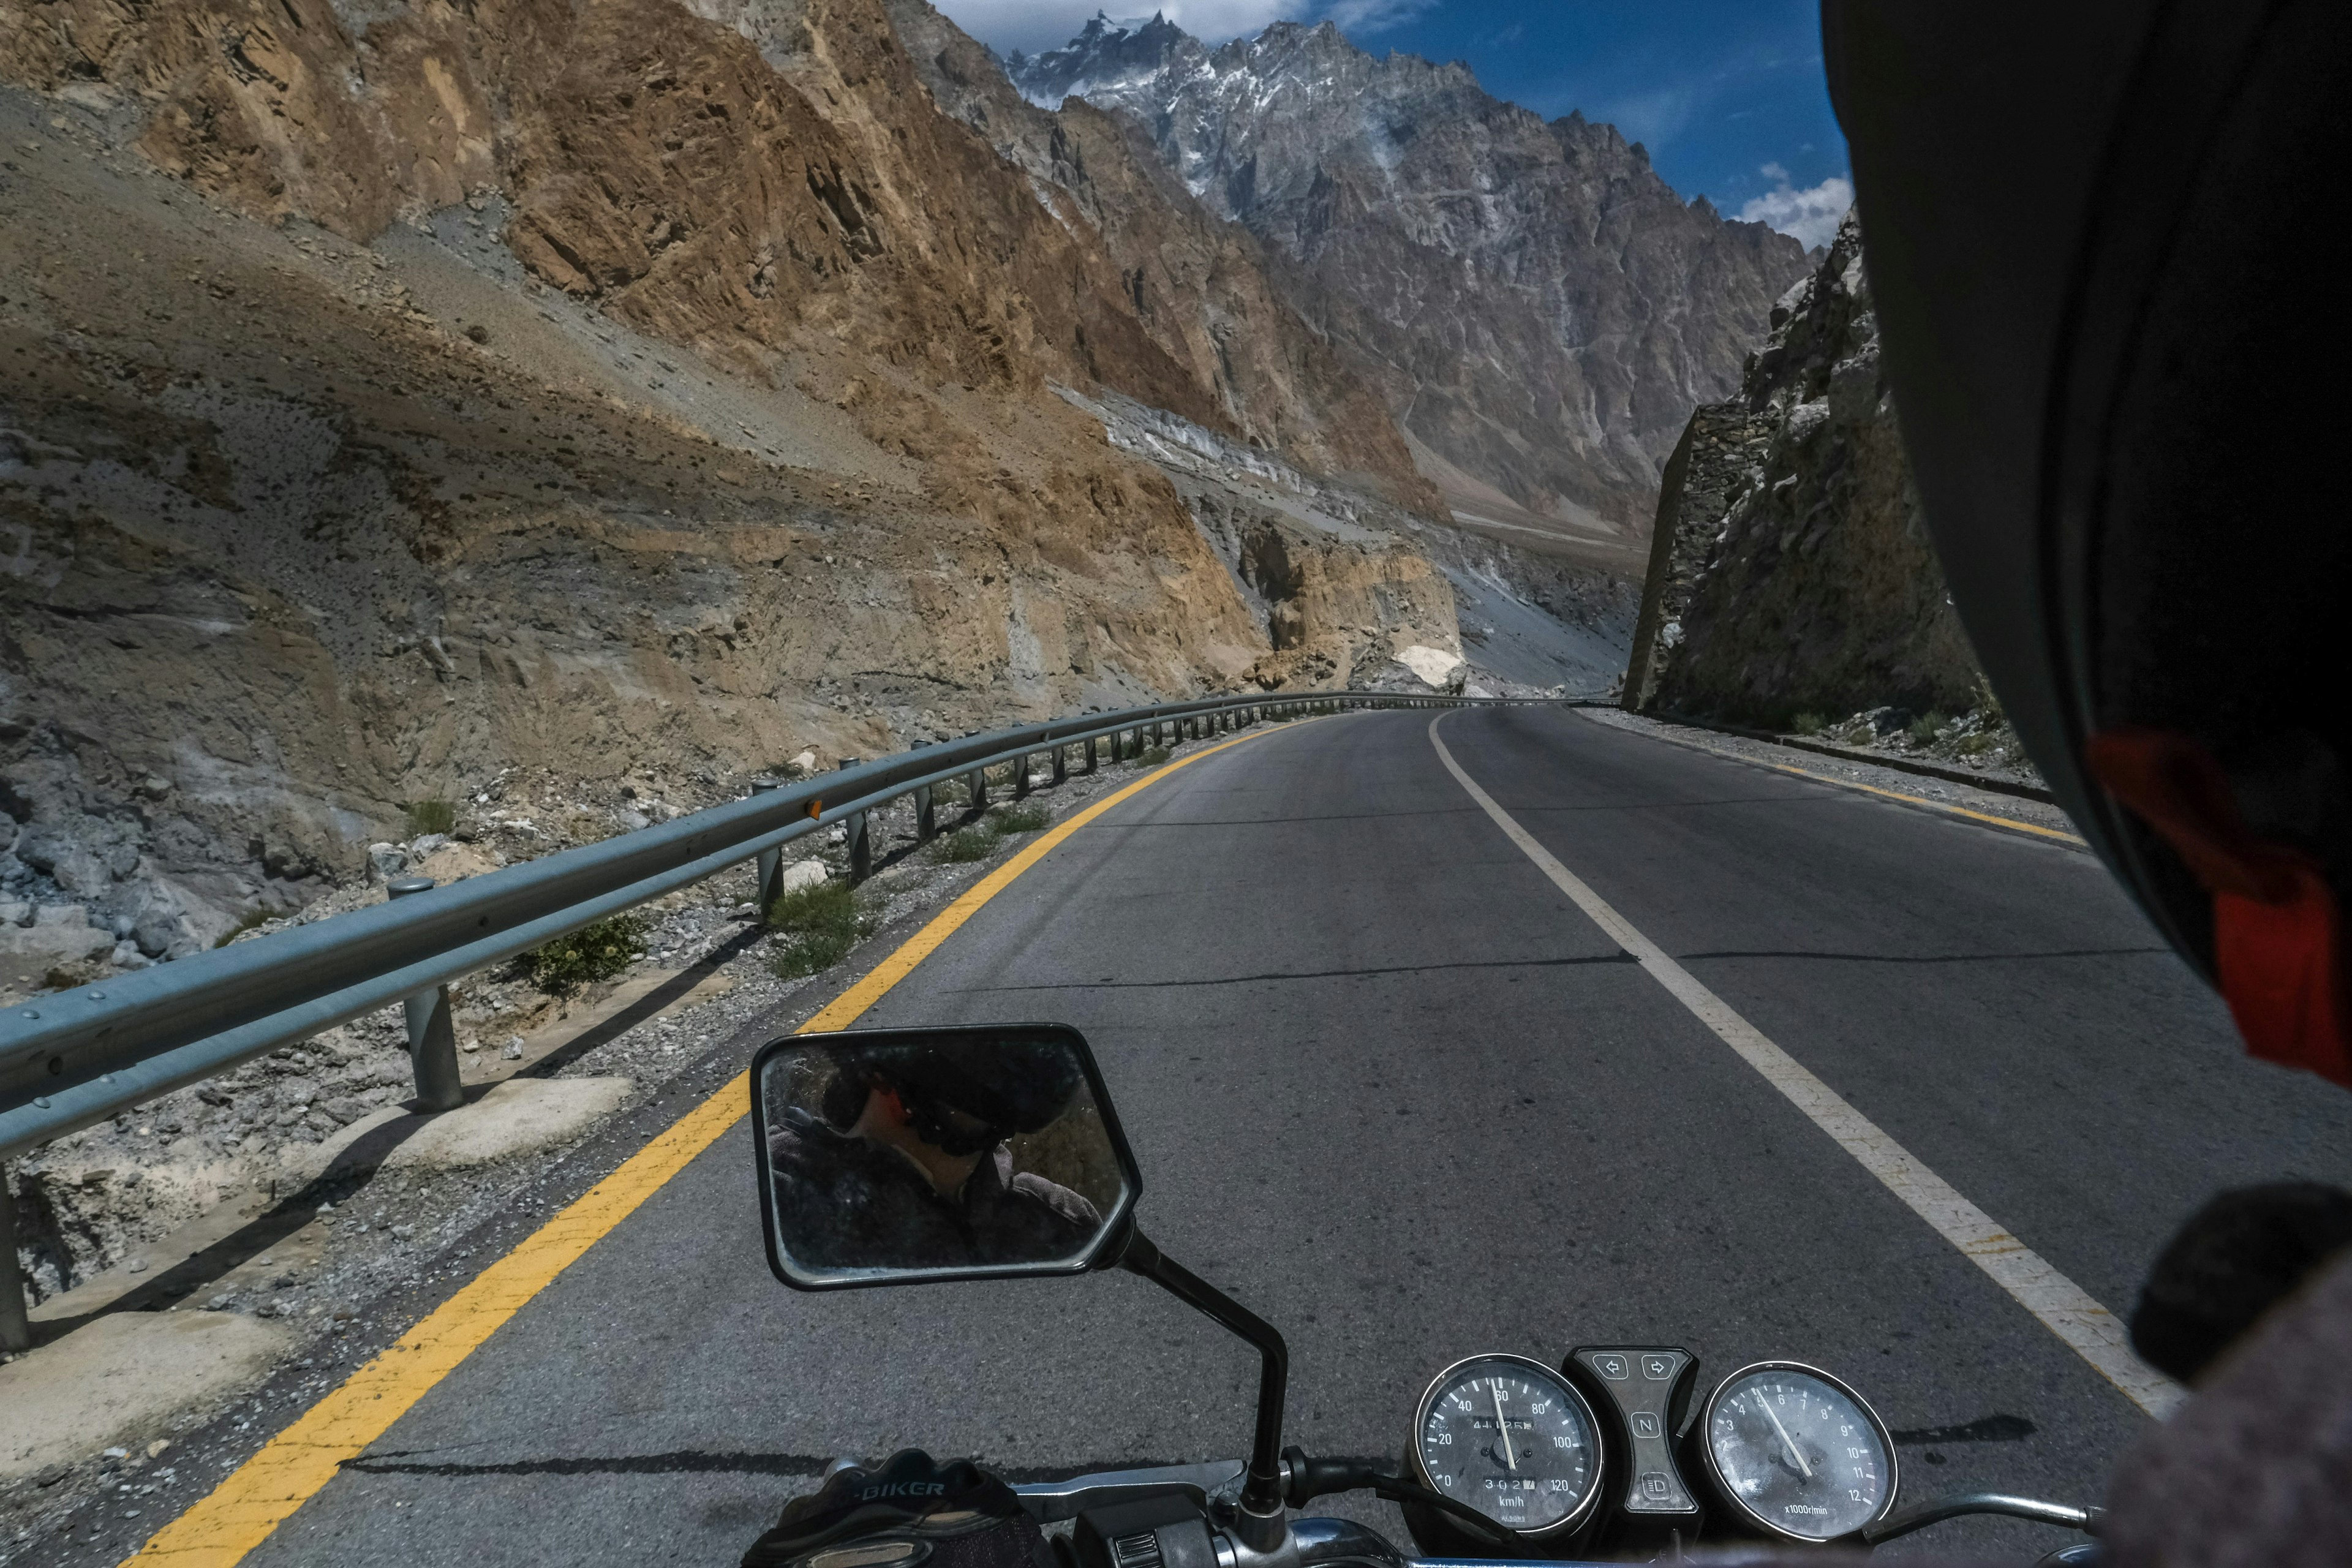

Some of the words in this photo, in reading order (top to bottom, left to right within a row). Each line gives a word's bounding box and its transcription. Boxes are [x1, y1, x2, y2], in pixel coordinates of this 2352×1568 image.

[1496, 1391, 1509, 1401] 60
[1778, 1394, 1785, 1405] 6
[1458, 1401, 1472, 1411] 40
[1532, 1404, 1545, 1414] 80
[1800, 1400, 1806, 1409] 7
[1738, 1405, 1746, 1415] 4
[1821, 1409, 1828, 1419] 8
[1640, 1419, 1652, 1431] N
[1727, 1420, 1734, 1431] 3
[1841, 1426, 1849, 1436] 9
[1439, 1434, 1452, 1444] 20
[1553, 1437, 1571, 1448] 100
[1847, 1447, 1859, 1458] 10
[1853, 1468, 1863, 1478] 11
[1444, 1476, 1452, 1486] 0
[1551, 1480, 1569, 1491] 120
[1849, 1490, 1861, 1501] 12
[1499, 1496, 1524, 1507] km/h
